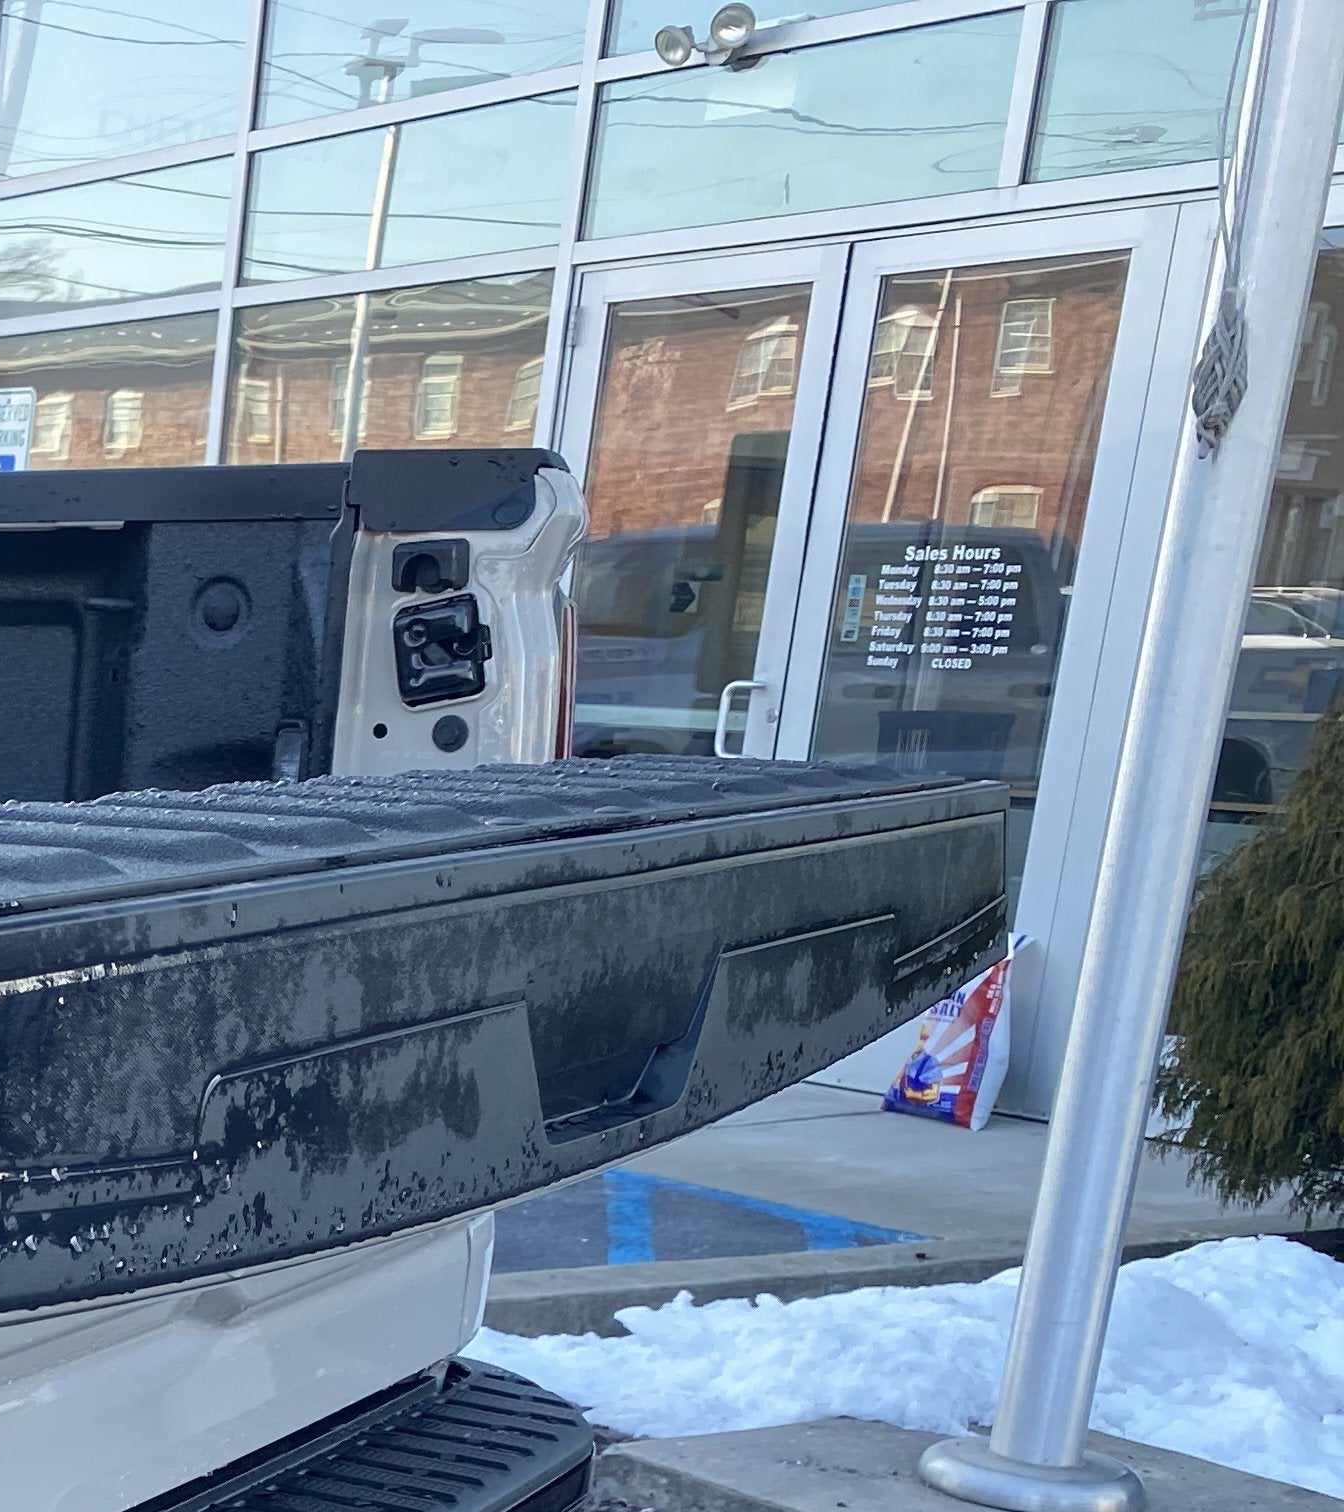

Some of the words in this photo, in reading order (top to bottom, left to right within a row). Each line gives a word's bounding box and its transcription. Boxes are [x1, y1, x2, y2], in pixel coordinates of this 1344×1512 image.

[904, 545, 948, 562] Sales
[952, 544, 1001, 561] Hours
[881, 564, 920, 577] Monday
[955, 565, 971, 574] am
[983, 563, 1004, 574] 7:00
[1005, 564, 1022, 576] pm
[878, 579, 917, 592] Tuesday
[952, 581, 968, 590] am
[980, 579, 1001, 590] 7:00
[1002, 580, 1018, 592] pm
[950, 597, 965, 606] am
[1000, 597, 1016, 608] pm
[874, 610, 913, 623] Thursday
[947, 613, 962, 622] am
[974, 610, 996, 622] 7:00
[996, 612, 1013, 624] pm
[871, 625, 902, 639] Friday
[944, 628, 960, 637] am
[972, 626, 994, 638] 7:00
[994, 628, 1010, 640] pm
[868, 641, 915, 654] Saturday
[942, 645, 958, 653] am
[969, 643, 991, 654] 3:00
[992, 645, 1008, 657] pm
[866, 655, 899, 669] Sunday
[931, 658, 972, 669] CLOSED
